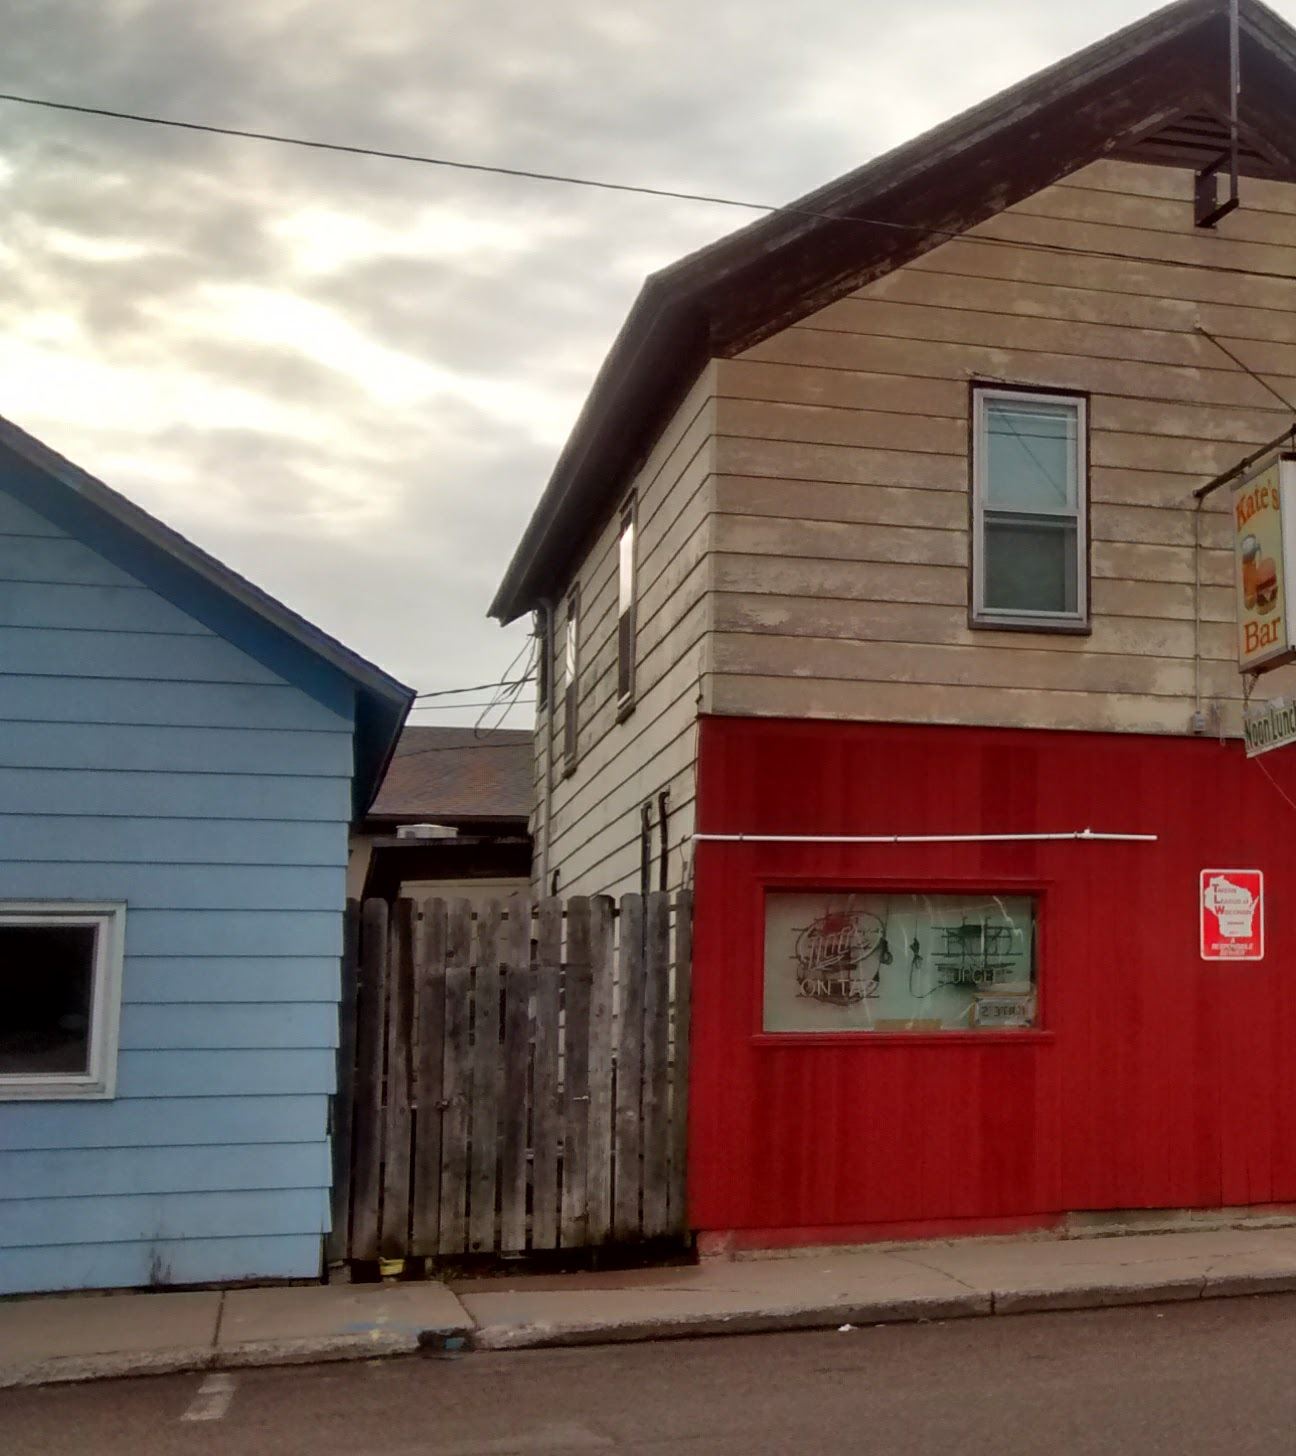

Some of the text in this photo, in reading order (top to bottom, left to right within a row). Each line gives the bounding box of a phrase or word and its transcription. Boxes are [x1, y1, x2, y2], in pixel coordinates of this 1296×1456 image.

[1236, 479, 1280, 532] Kate's
[1244, 617, 1281, 653] Bar
[800, 979, 832, 997] ON
